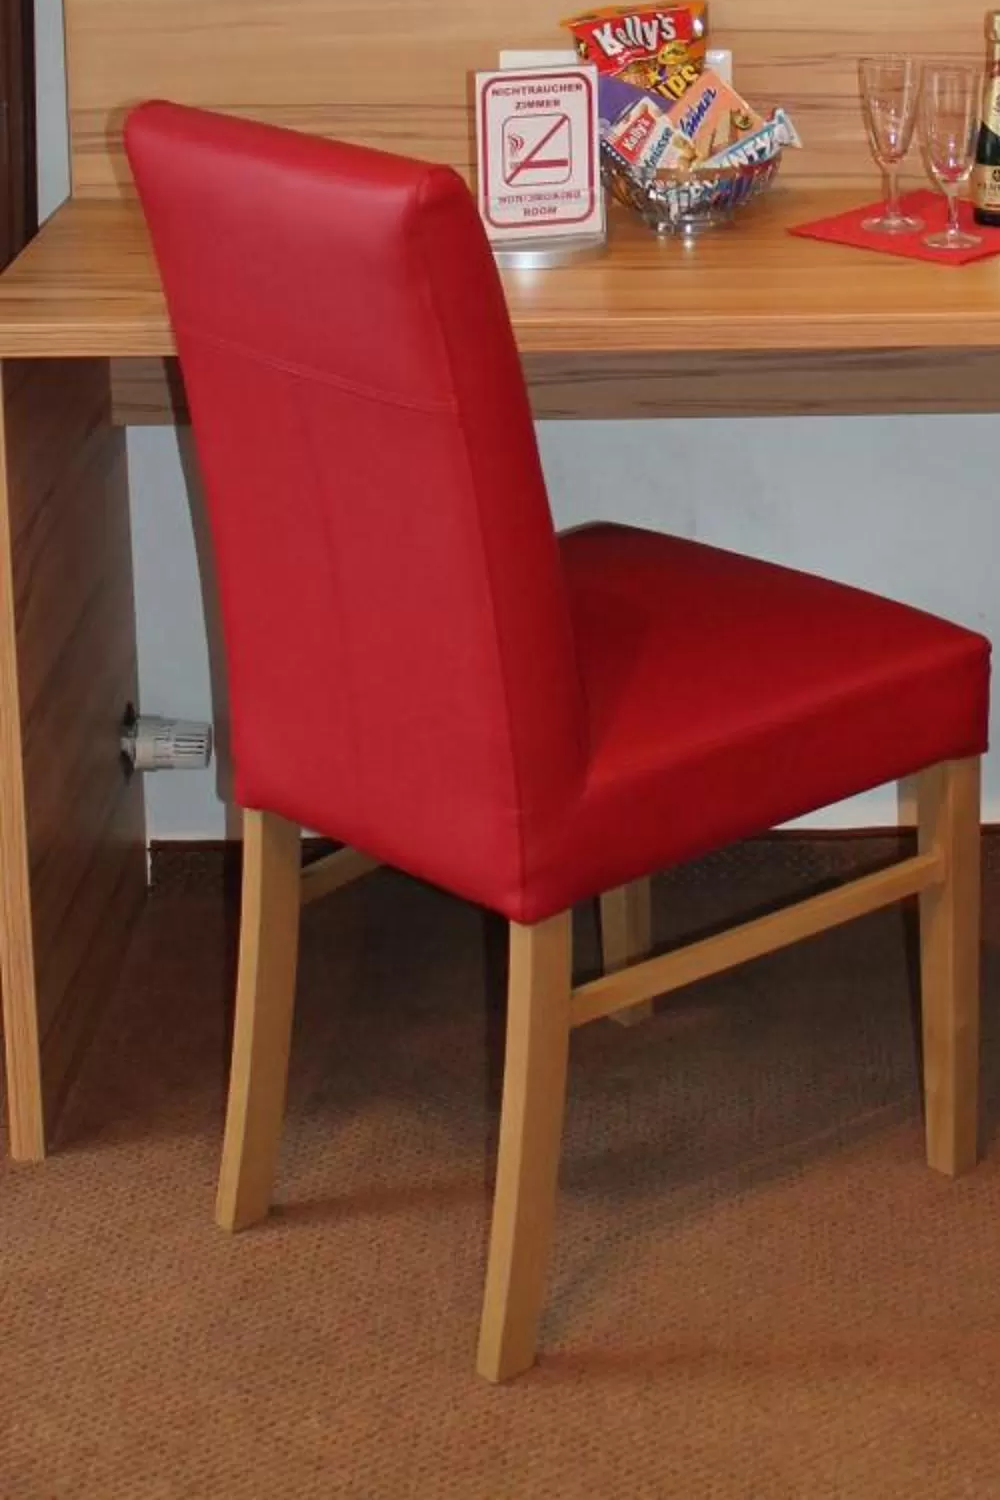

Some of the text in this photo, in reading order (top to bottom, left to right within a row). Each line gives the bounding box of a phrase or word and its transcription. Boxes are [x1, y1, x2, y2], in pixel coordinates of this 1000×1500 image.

[592, 13, 676, 56] Kelly's
[491, 83, 583, 96] NICHTRAUCHER
[515, 100, 561, 110] ZIMMER
[523, 206, 557, 216] ROOM
